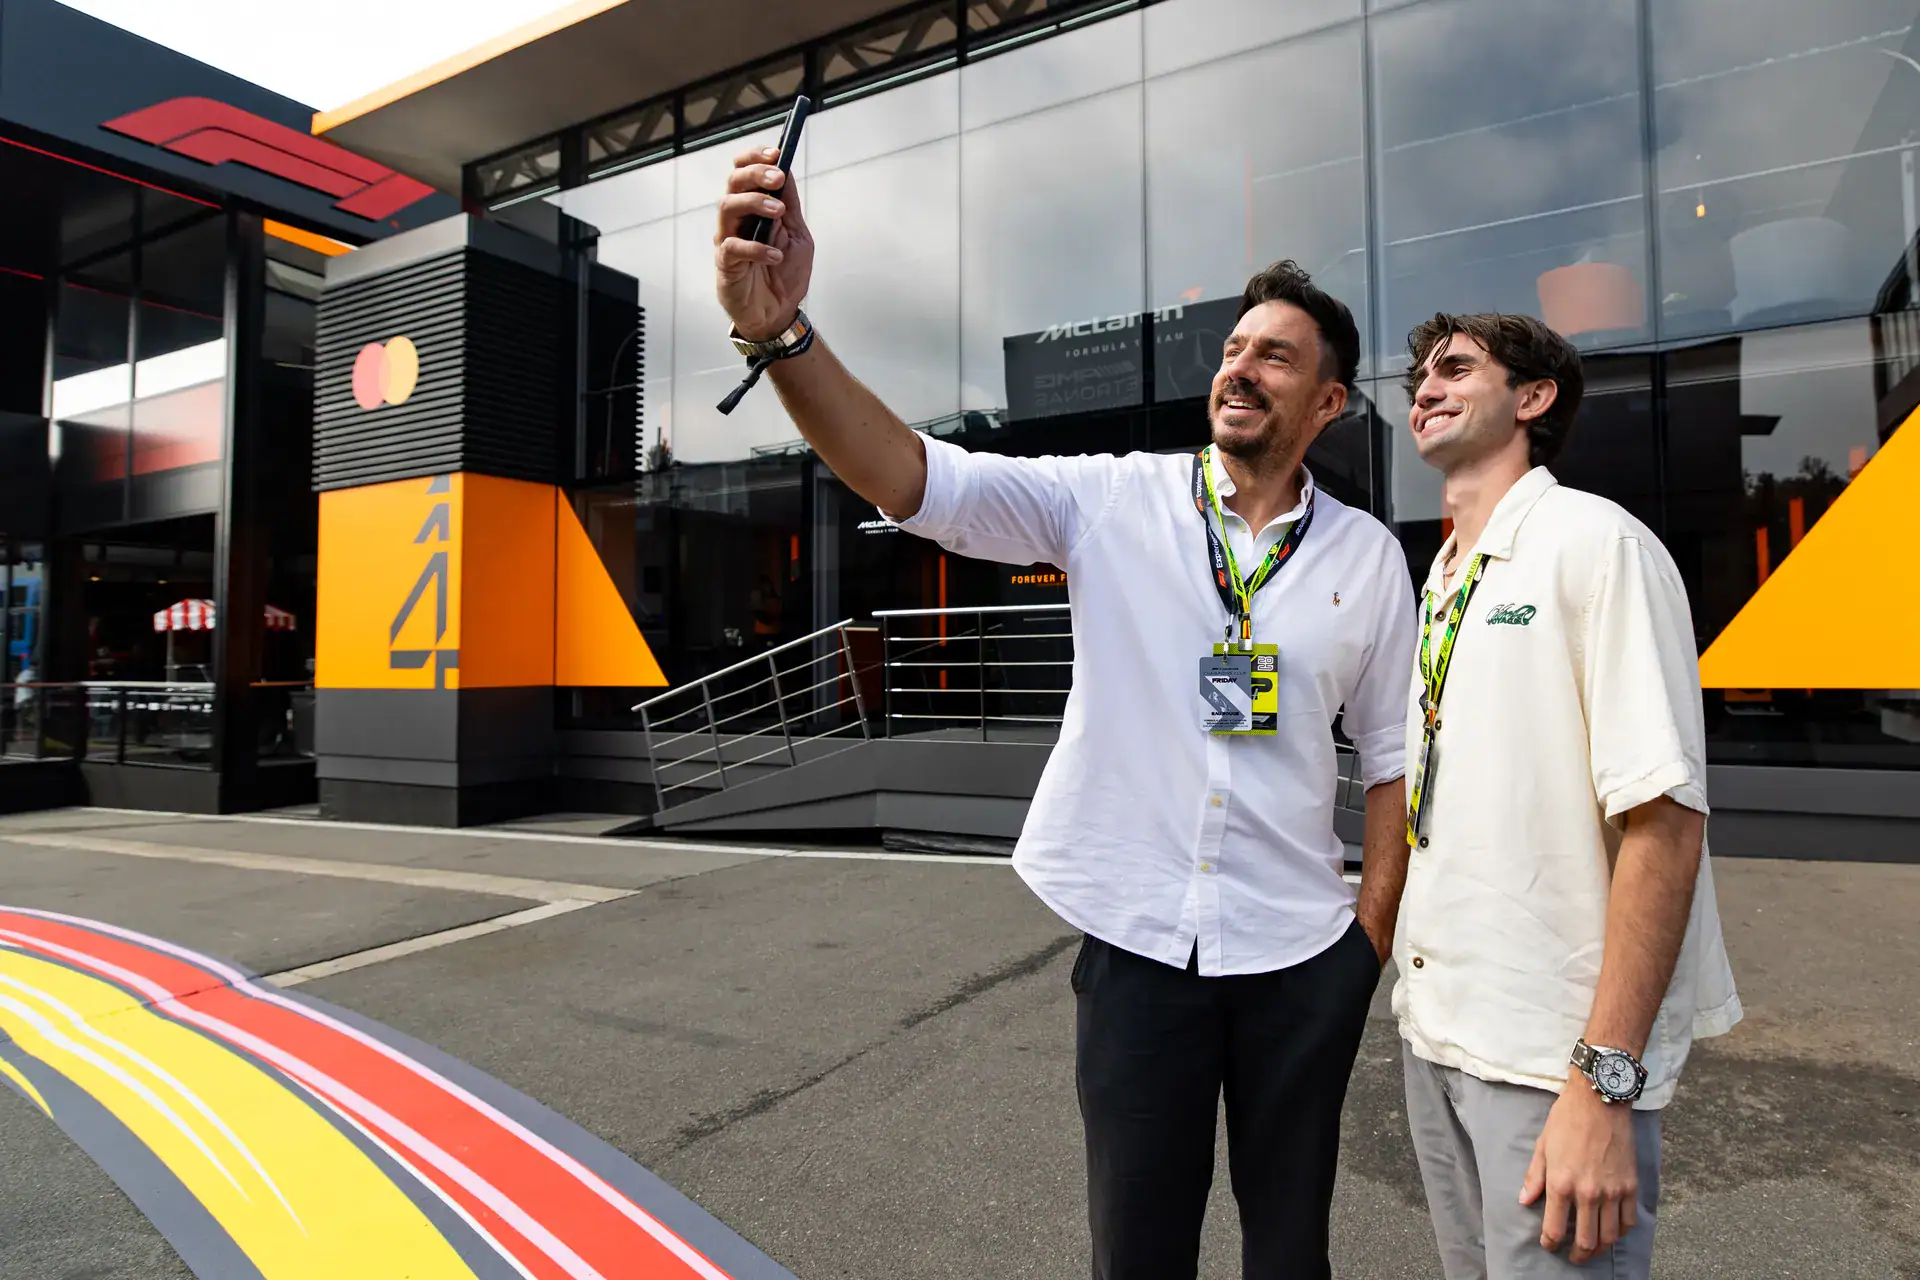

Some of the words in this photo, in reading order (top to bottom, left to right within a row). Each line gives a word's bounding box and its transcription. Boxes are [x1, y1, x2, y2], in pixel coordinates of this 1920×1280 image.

[1065, 342, 1127, 358] FORMULA
[1011, 574, 1056, 584] FOREVER
[1448, 608, 1461, 624] VIP
